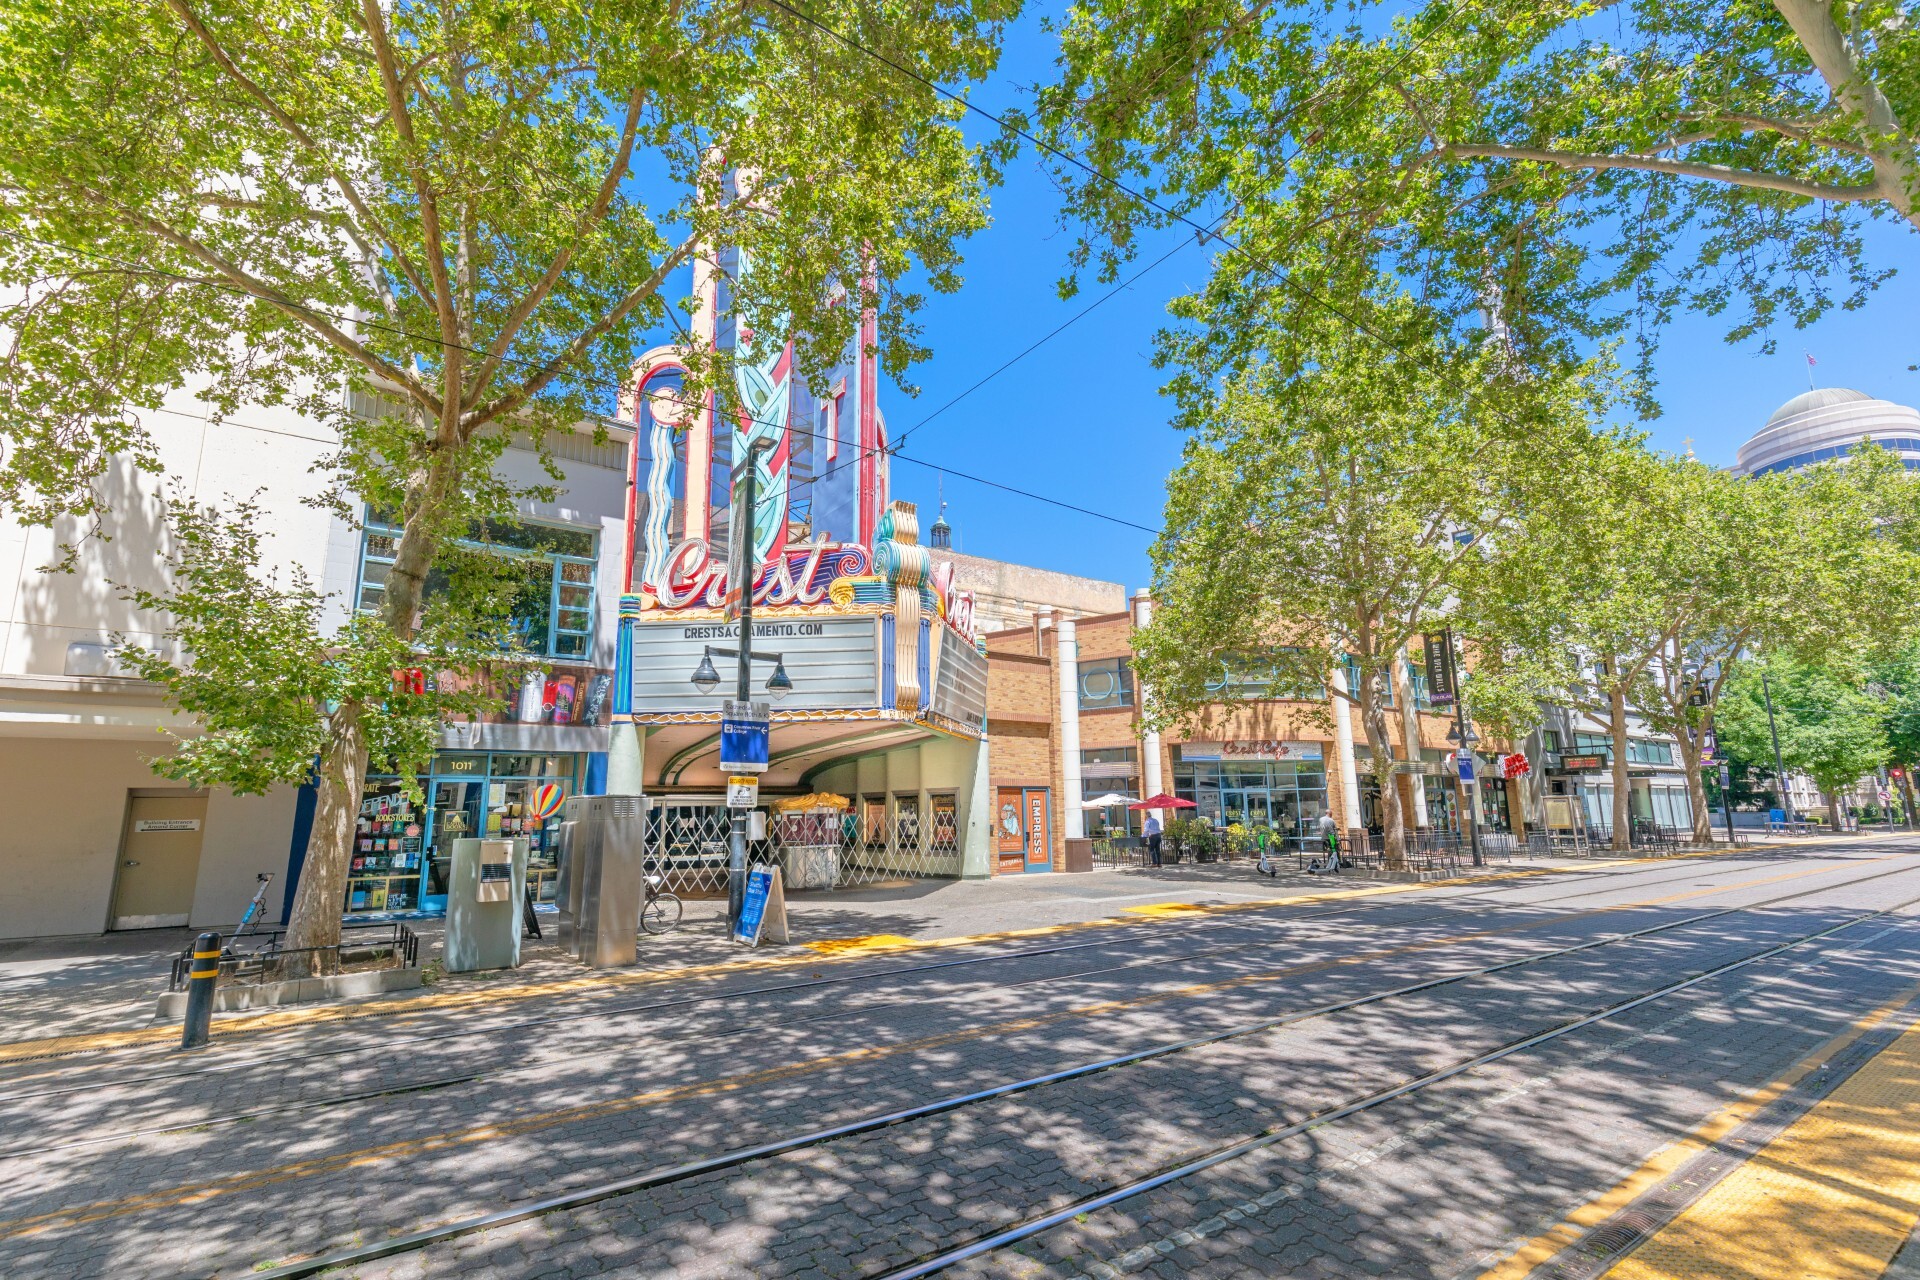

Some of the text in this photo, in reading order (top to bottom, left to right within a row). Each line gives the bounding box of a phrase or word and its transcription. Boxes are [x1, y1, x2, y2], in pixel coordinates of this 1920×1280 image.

[684, 623, 823, 639] CRESTSACAMENTO.COM
[1432, 643, 1445, 692] WIDE OPEN WALLS
[725, 703, 753, 712] Cathedral
[1223, 740, 1290, 760] Crest Cafe
[451, 762, 472, 770] 1011
[363, 783, 380, 793] RATE
[375, 813, 415, 822] BOOKSTORES
[1032, 799, 1042, 854] EMPRESS
[999, 858, 1024, 867] ENTRANCE
